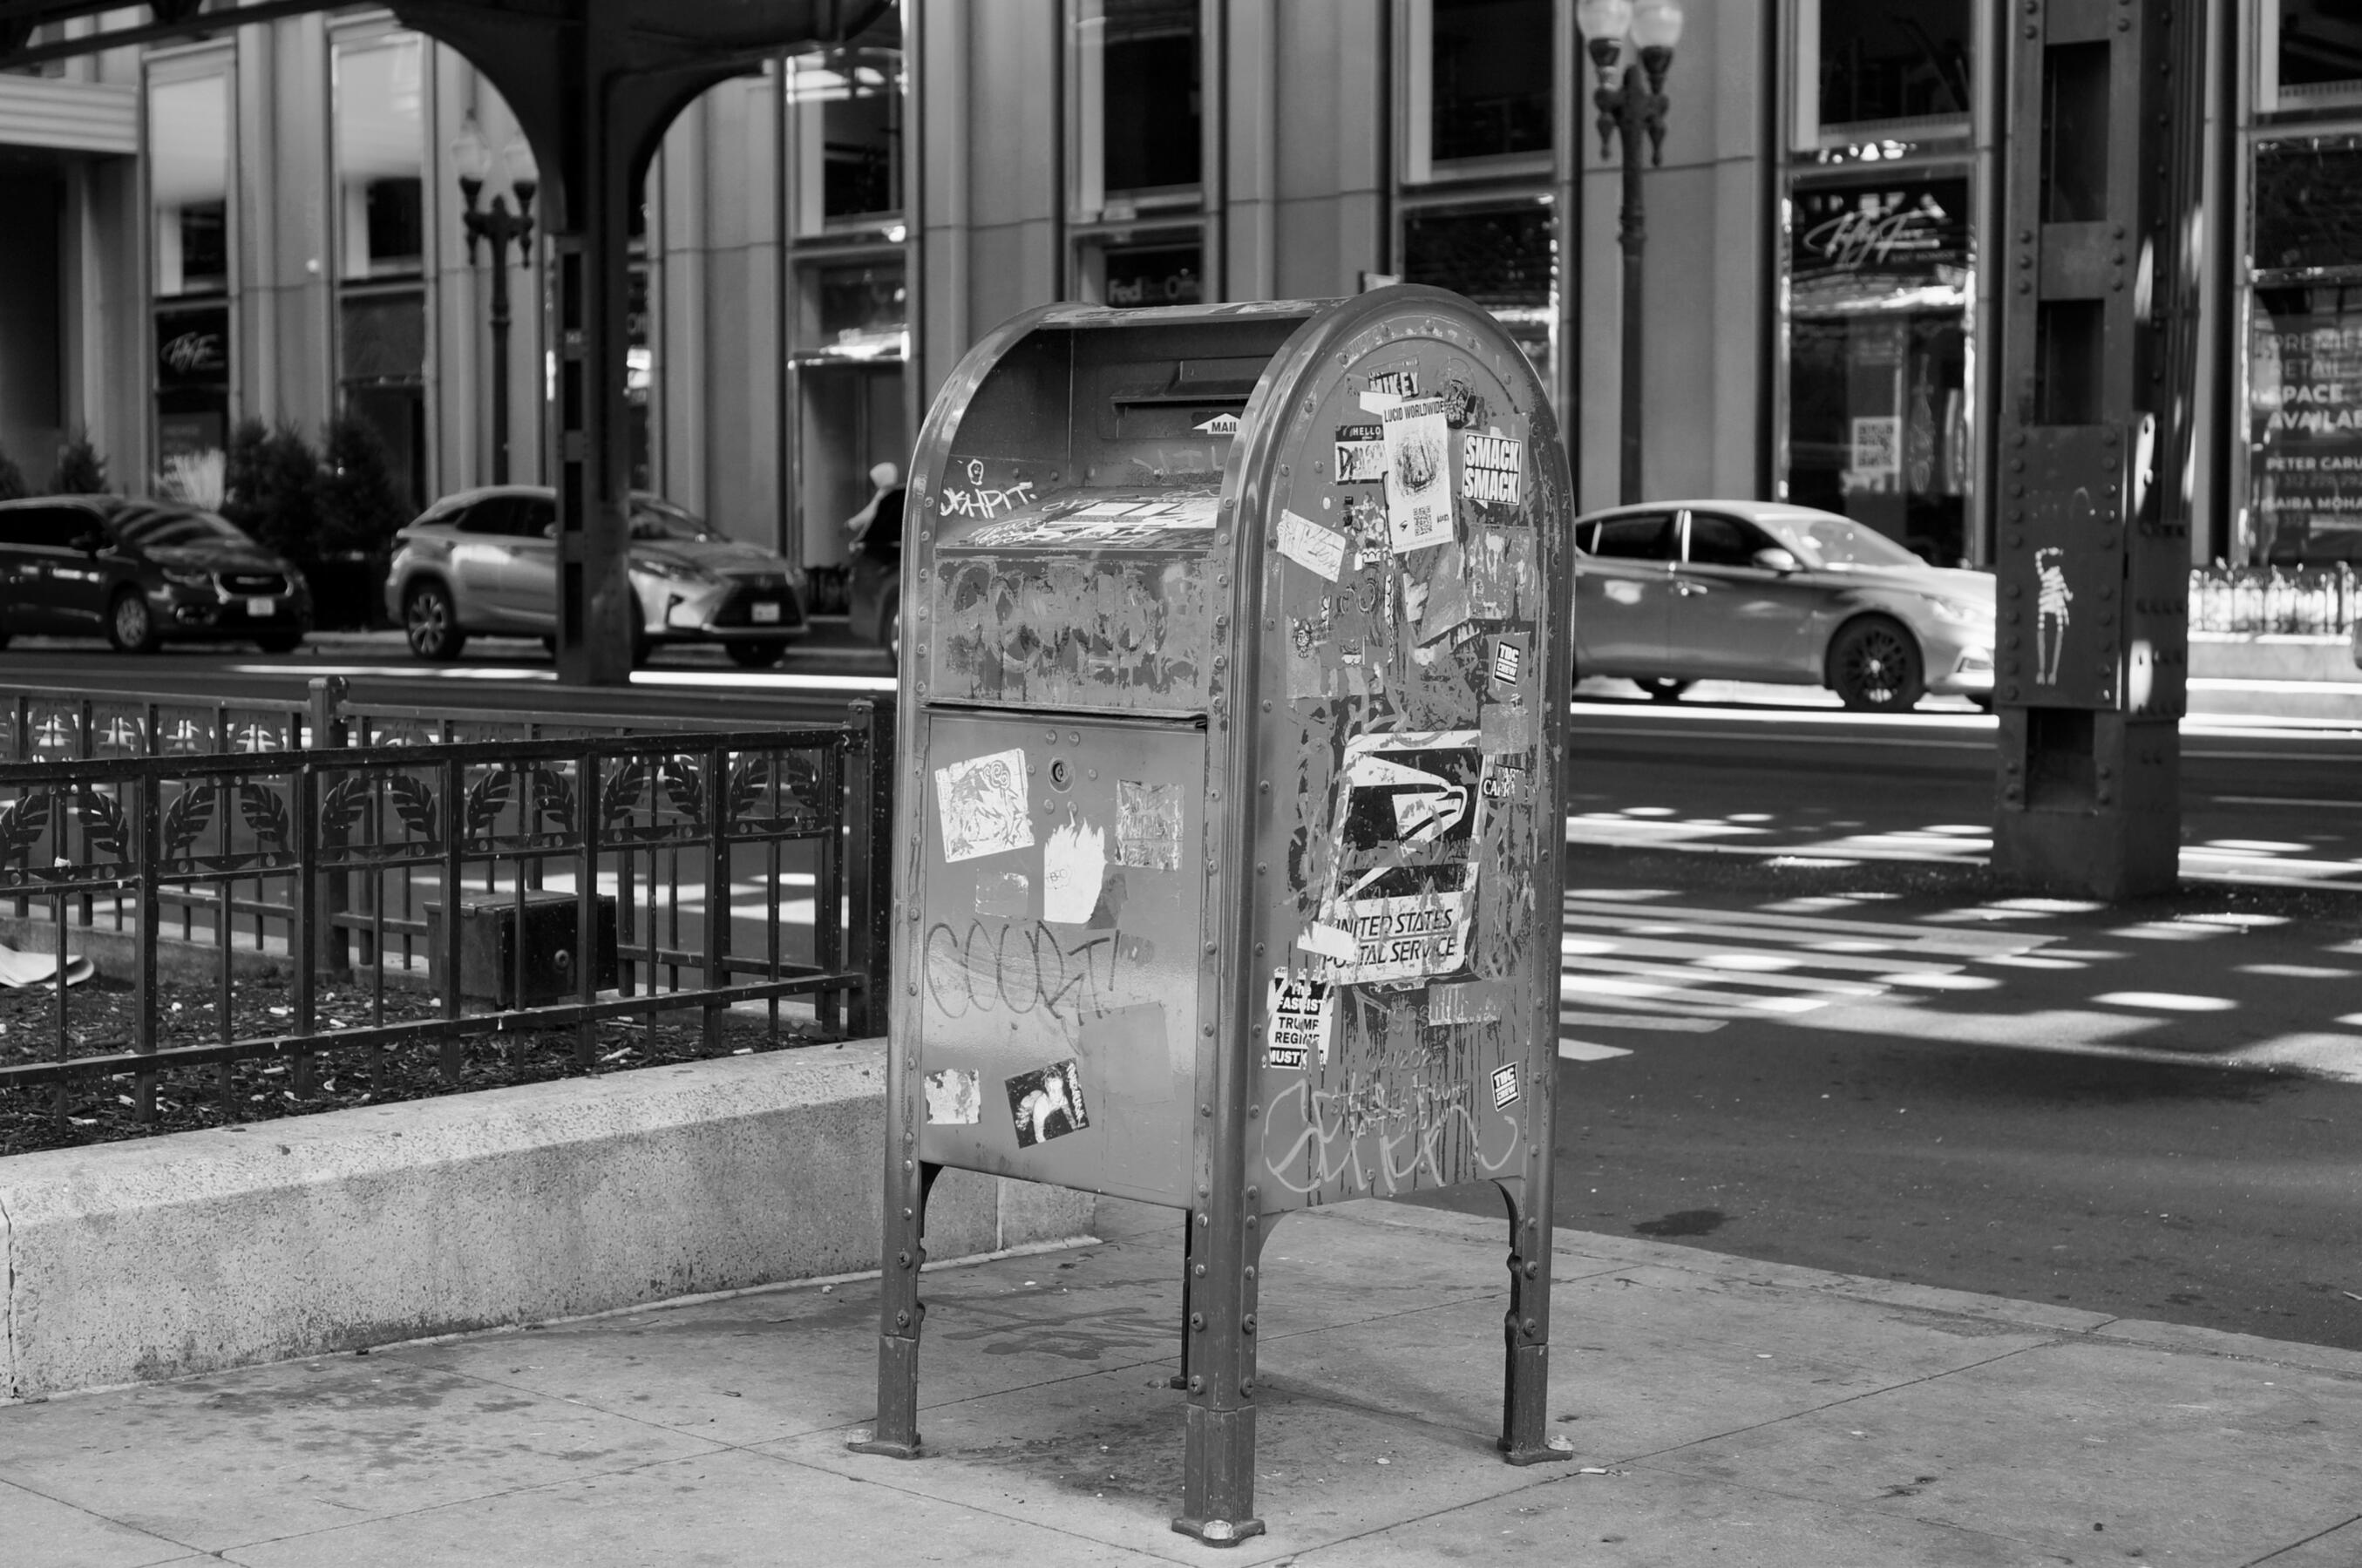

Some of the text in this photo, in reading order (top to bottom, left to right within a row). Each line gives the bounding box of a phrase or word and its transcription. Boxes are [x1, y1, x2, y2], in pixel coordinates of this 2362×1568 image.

[1383, 400, 1444, 423] LUCID WORLDWIDE
[1352, 425, 1381, 436] HELLO
[1465, 435, 1519, 472] SMACK
[1464, 467, 1518, 503] SMACK
[1395, 908, 1454, 934] STATES
